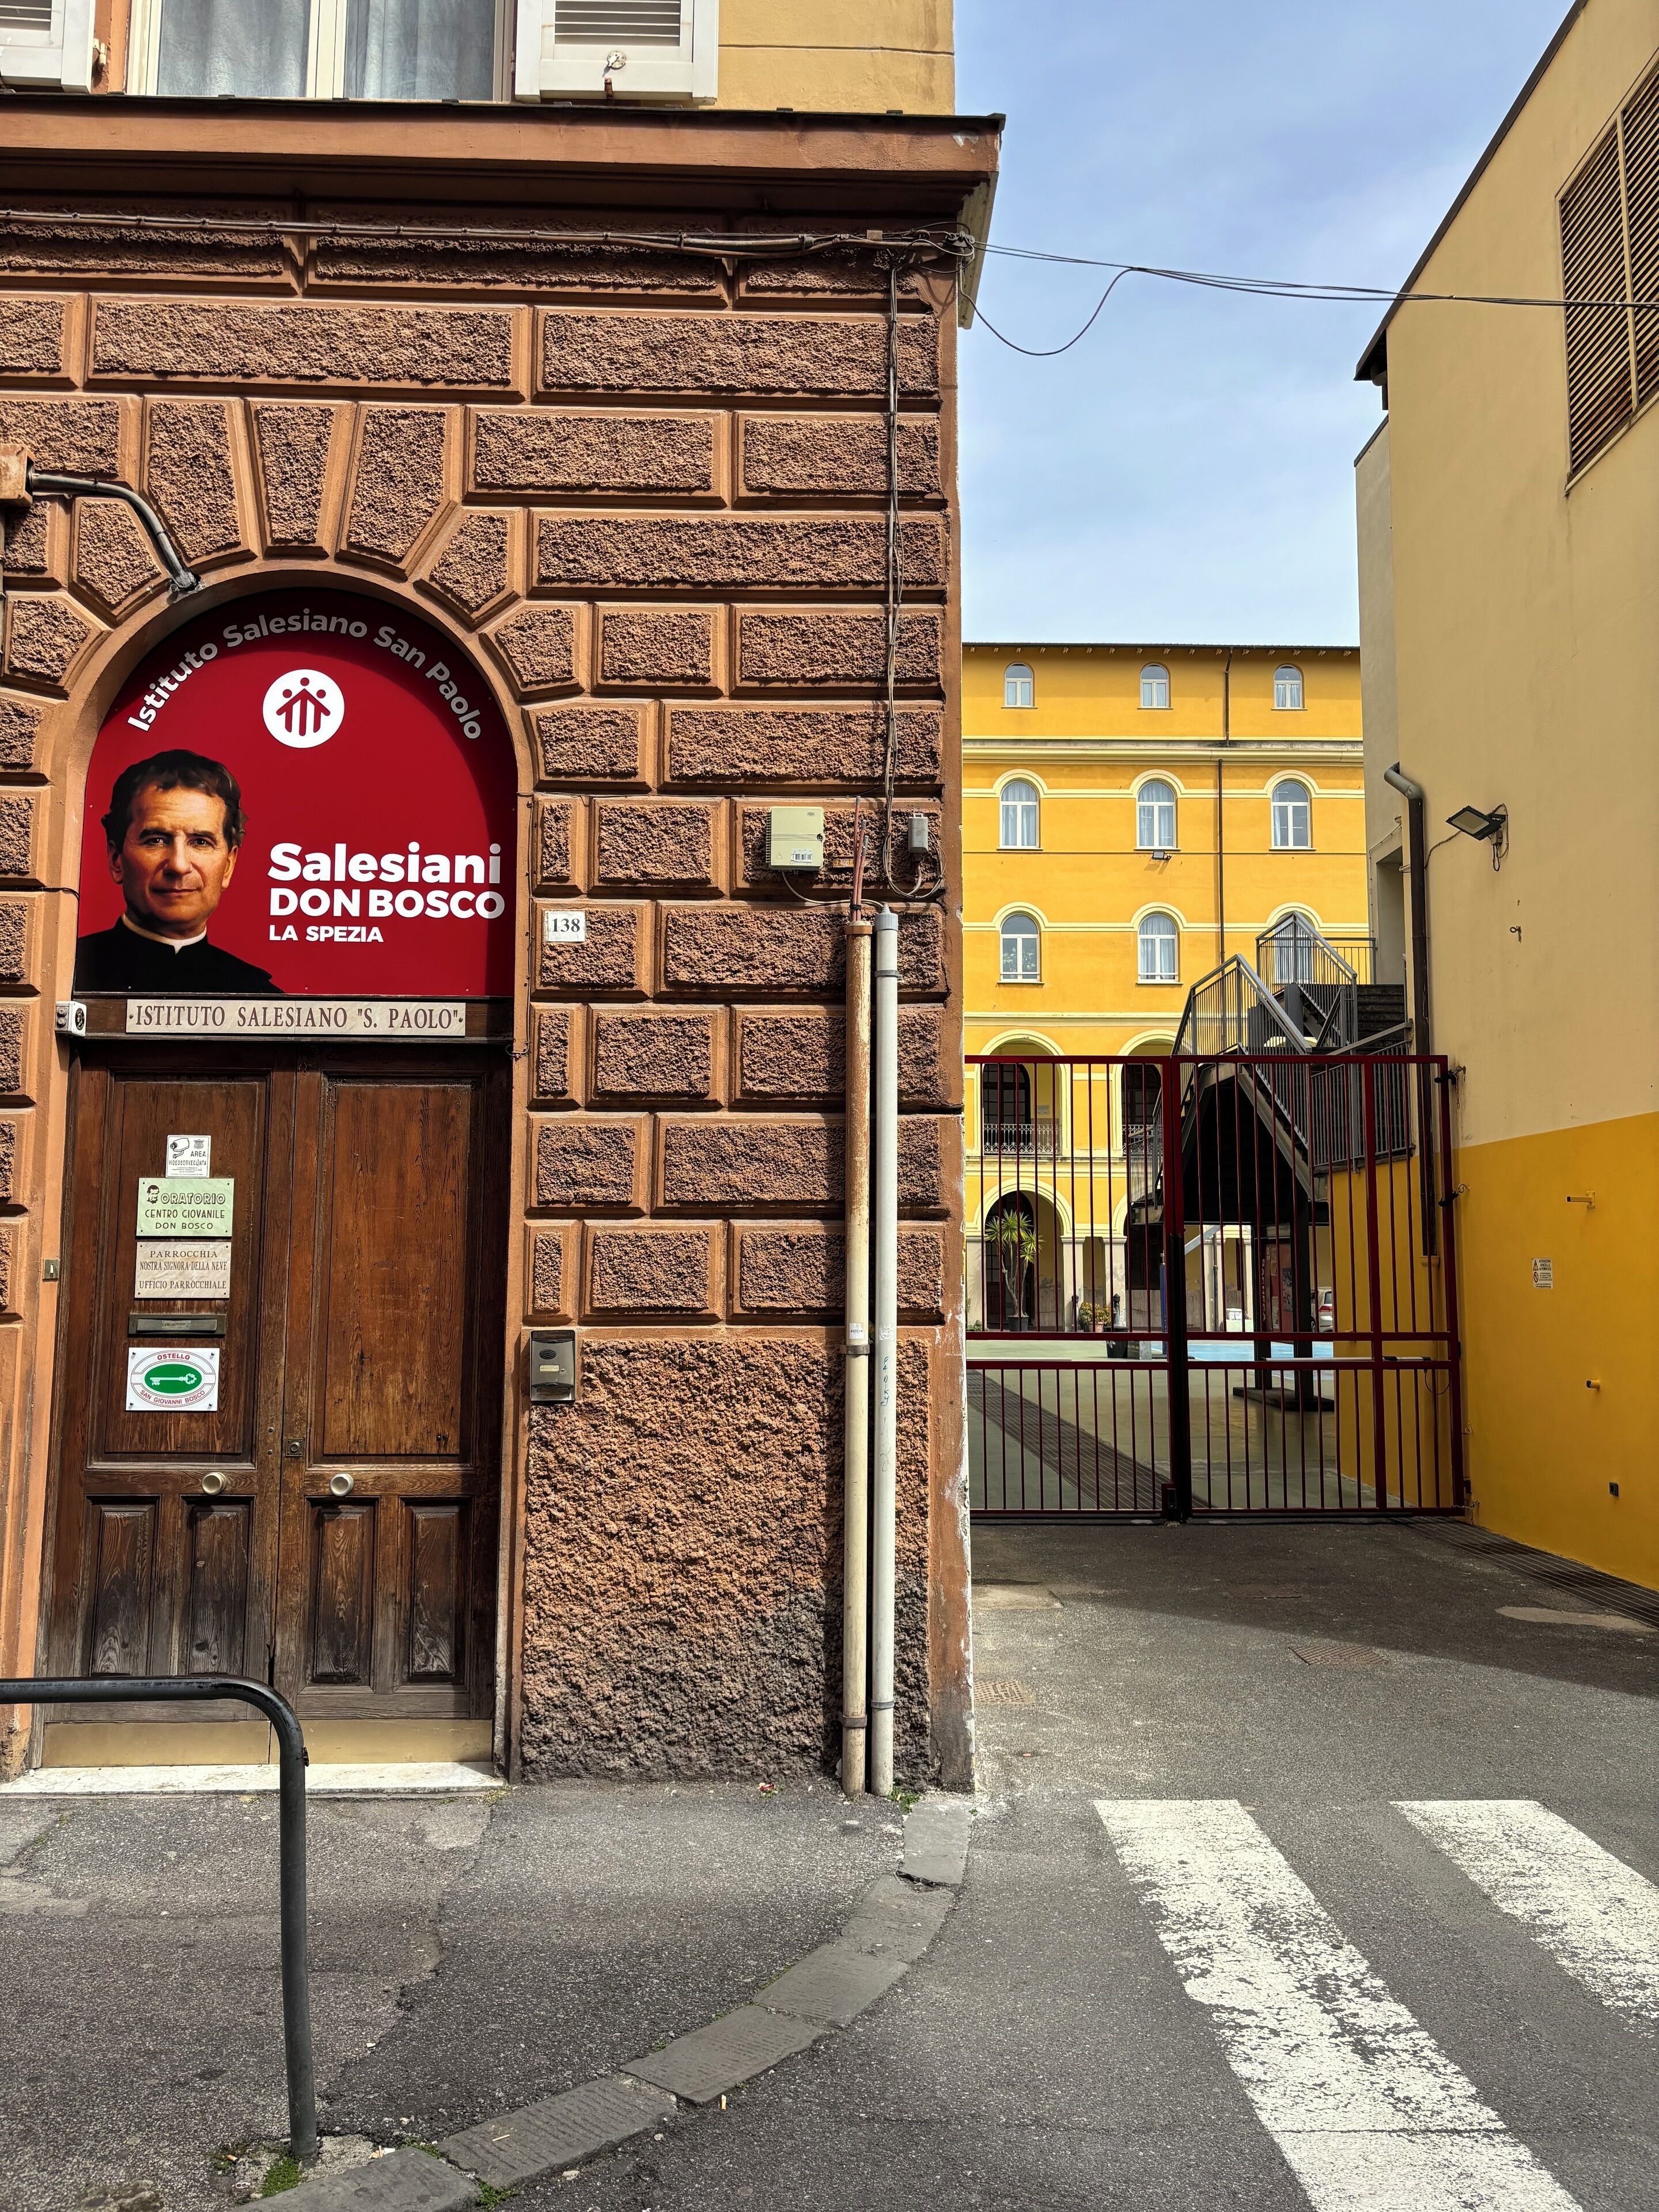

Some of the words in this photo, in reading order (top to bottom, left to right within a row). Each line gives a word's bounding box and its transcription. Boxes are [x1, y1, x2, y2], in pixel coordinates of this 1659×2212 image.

[127, 643, 218, 732] Istituto
[223, 608, 368, 649] Salesiano
[373, 626, 426, 669] San
[425, 661, 482, 740] Paolo
[268, 842, 501, 884] Salesiani
[270, 888, 359, 916] DON
[369, 889, 505, 919] BOSCO
[552, 918, 580, 932] 138
[269, 925, 298, 941] LA
[306, 926, 384, 943] SPEZIA
[135, 1006, 225, 1026] ISTITUTO
[237, 1007, 347, 1028] SALESIANO
[357, 1009, 378, 1029] "S.
[389, 1009, 459, 1029] PAOLO"
[161, 1193, 225, 1205] ORATORIO
[145, 1210, 178, 1218] CENTRO
[182, 1210, 225, 1218] GIOVANILE
[140, 1261, 162, 1270] NOSTRA
[164, 1261, 189, 1271] SIGNORA
[191, 1262, 209, 1271] DELLA
[211, 1262, 228, 1271] NEVE
[139, 1281, 167, 1289] UFFICIO
[170, 1281, 226, 1289] PARROCCHIALE
[140, 1389, 151, 1400] SAN
[153, 1397, 182, 1405] GIOVANNI
[185, 1390, 205, 1403] BOSCO
